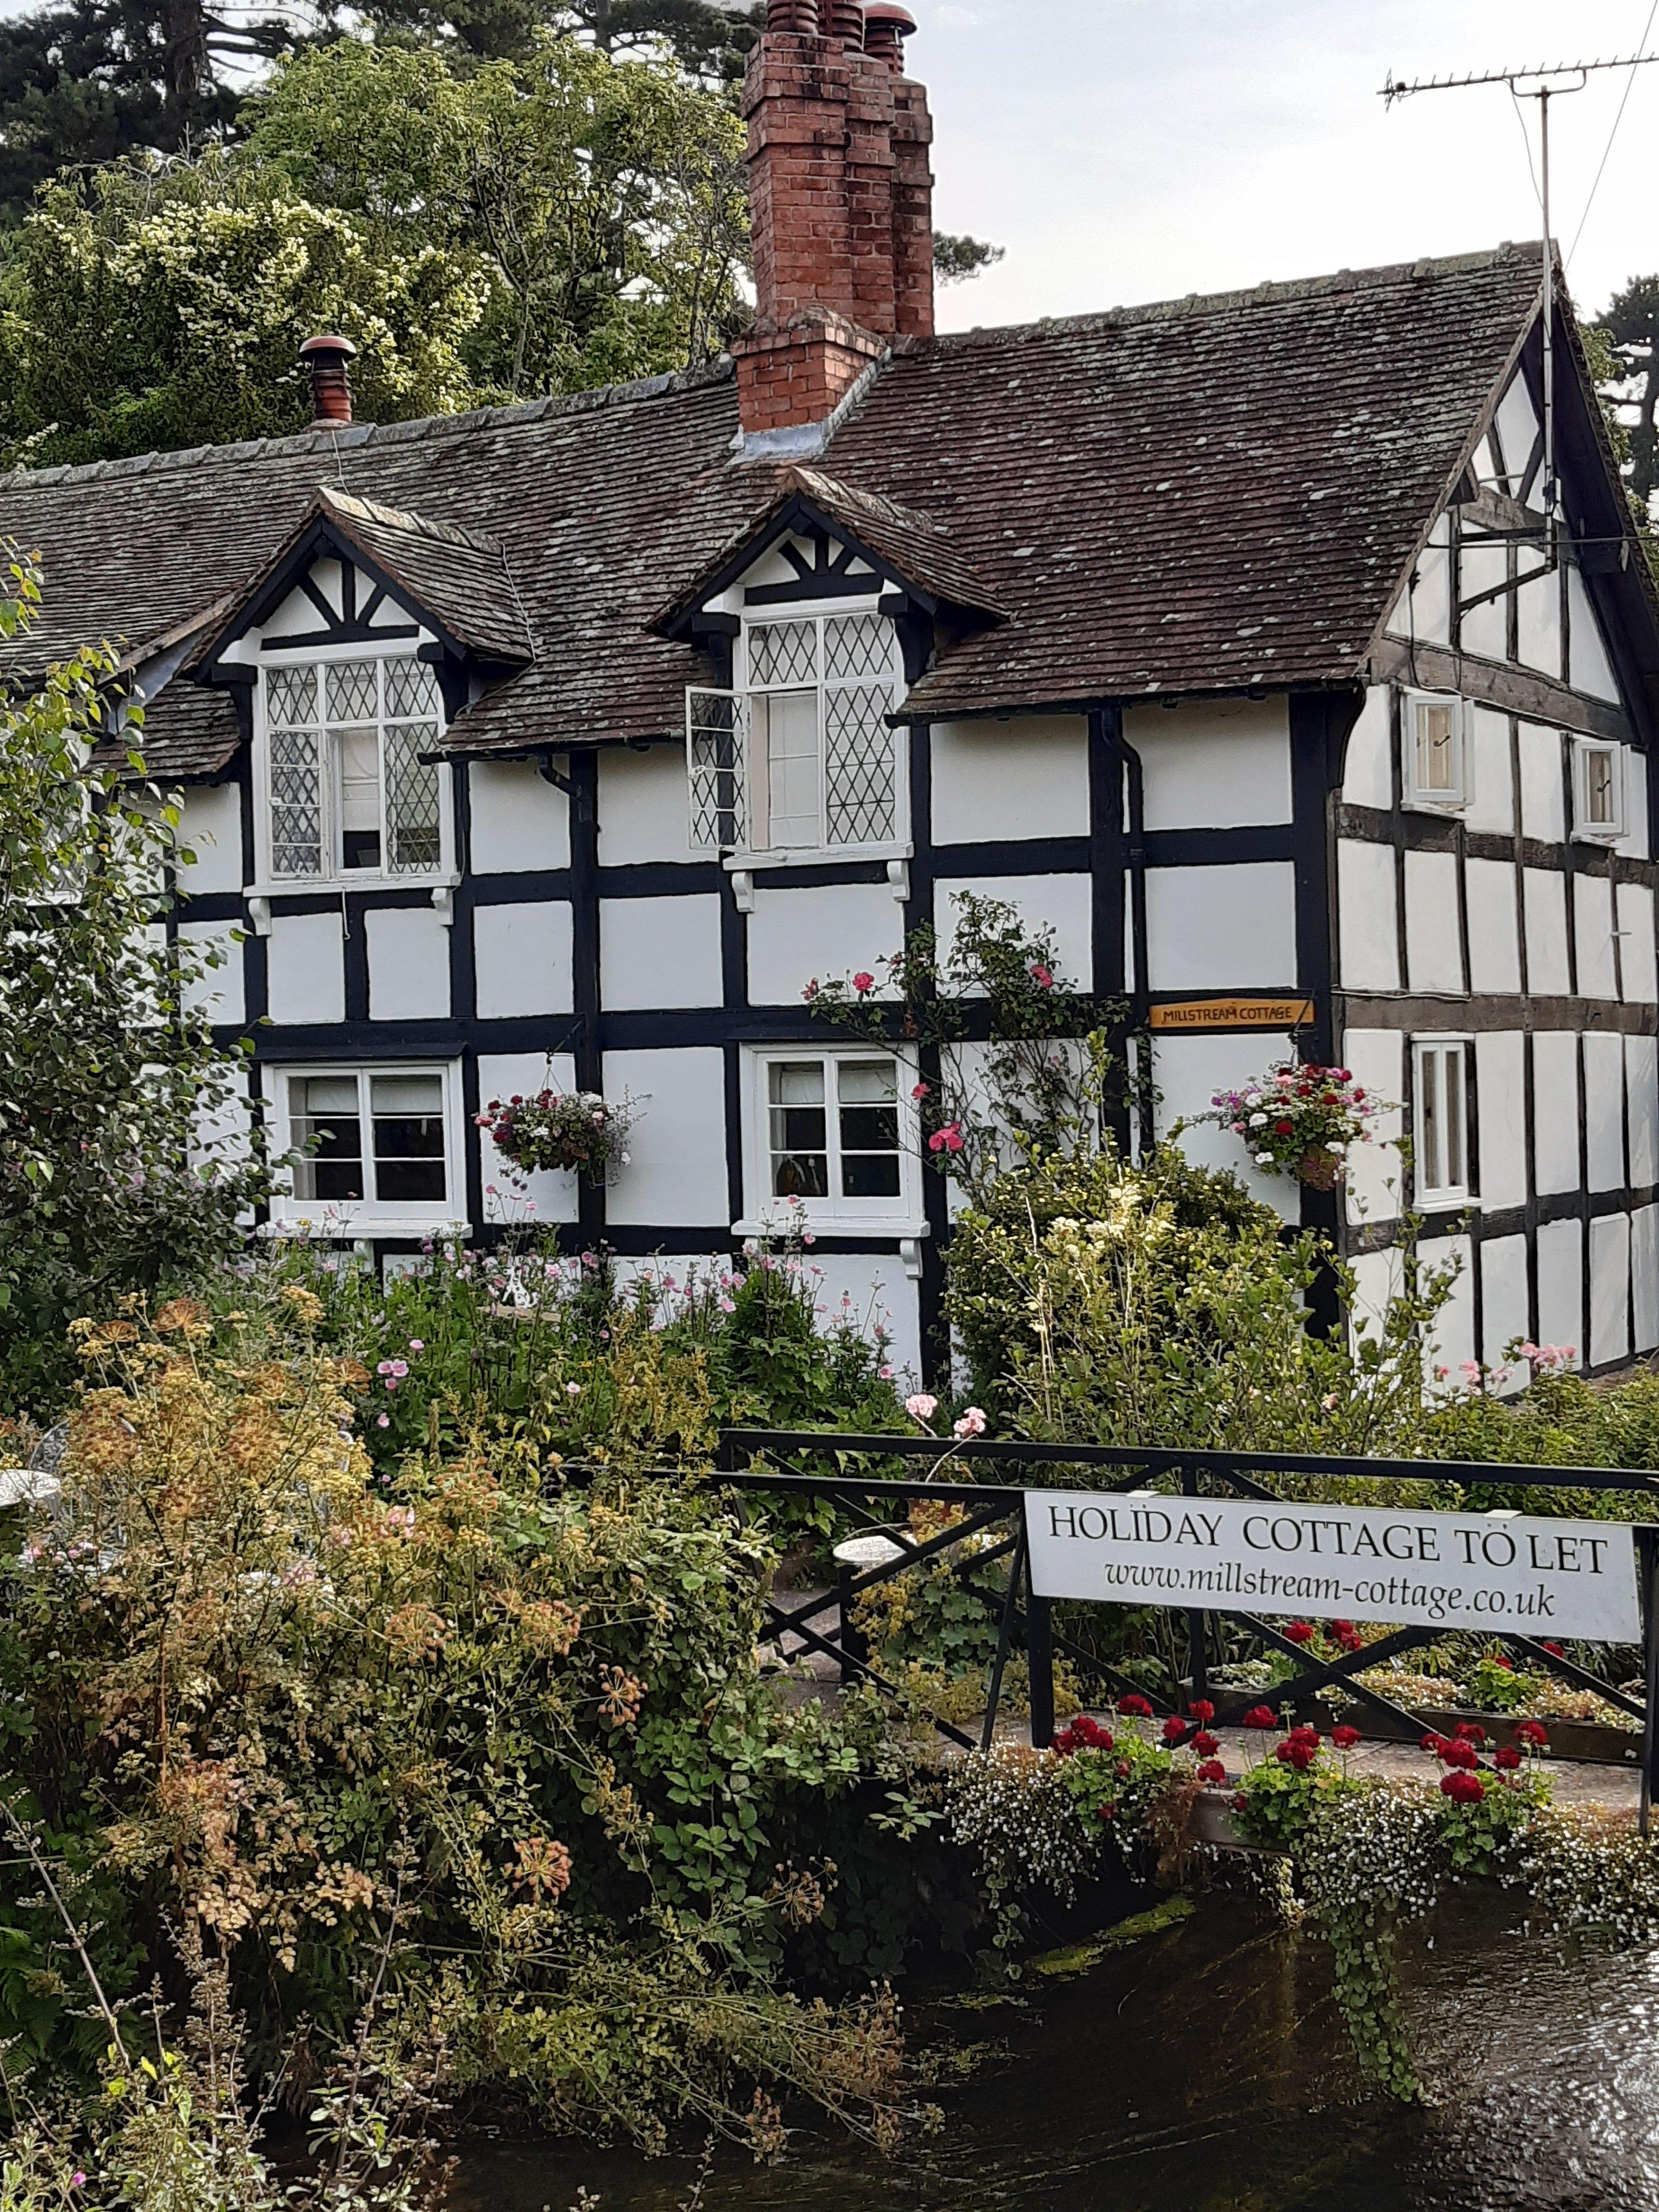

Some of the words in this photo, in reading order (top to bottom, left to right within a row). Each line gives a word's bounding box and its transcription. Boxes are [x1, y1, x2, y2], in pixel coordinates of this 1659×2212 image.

[1163, 1007, 1238, 1022] MILLSTREAM
[1239, 1006, 1292, 1020] COTTAGE
[1048, 1506, 1223, 1547] HOLIDAY
[1242, 1515, 1441, 1562] COTTAGE
[1454, 1529, 1516, 1567] TO
[1526, 1534, 1609, 1574] LET
[1105, 1562, 1555, 1620] www.millstream-cottage.co.uk
